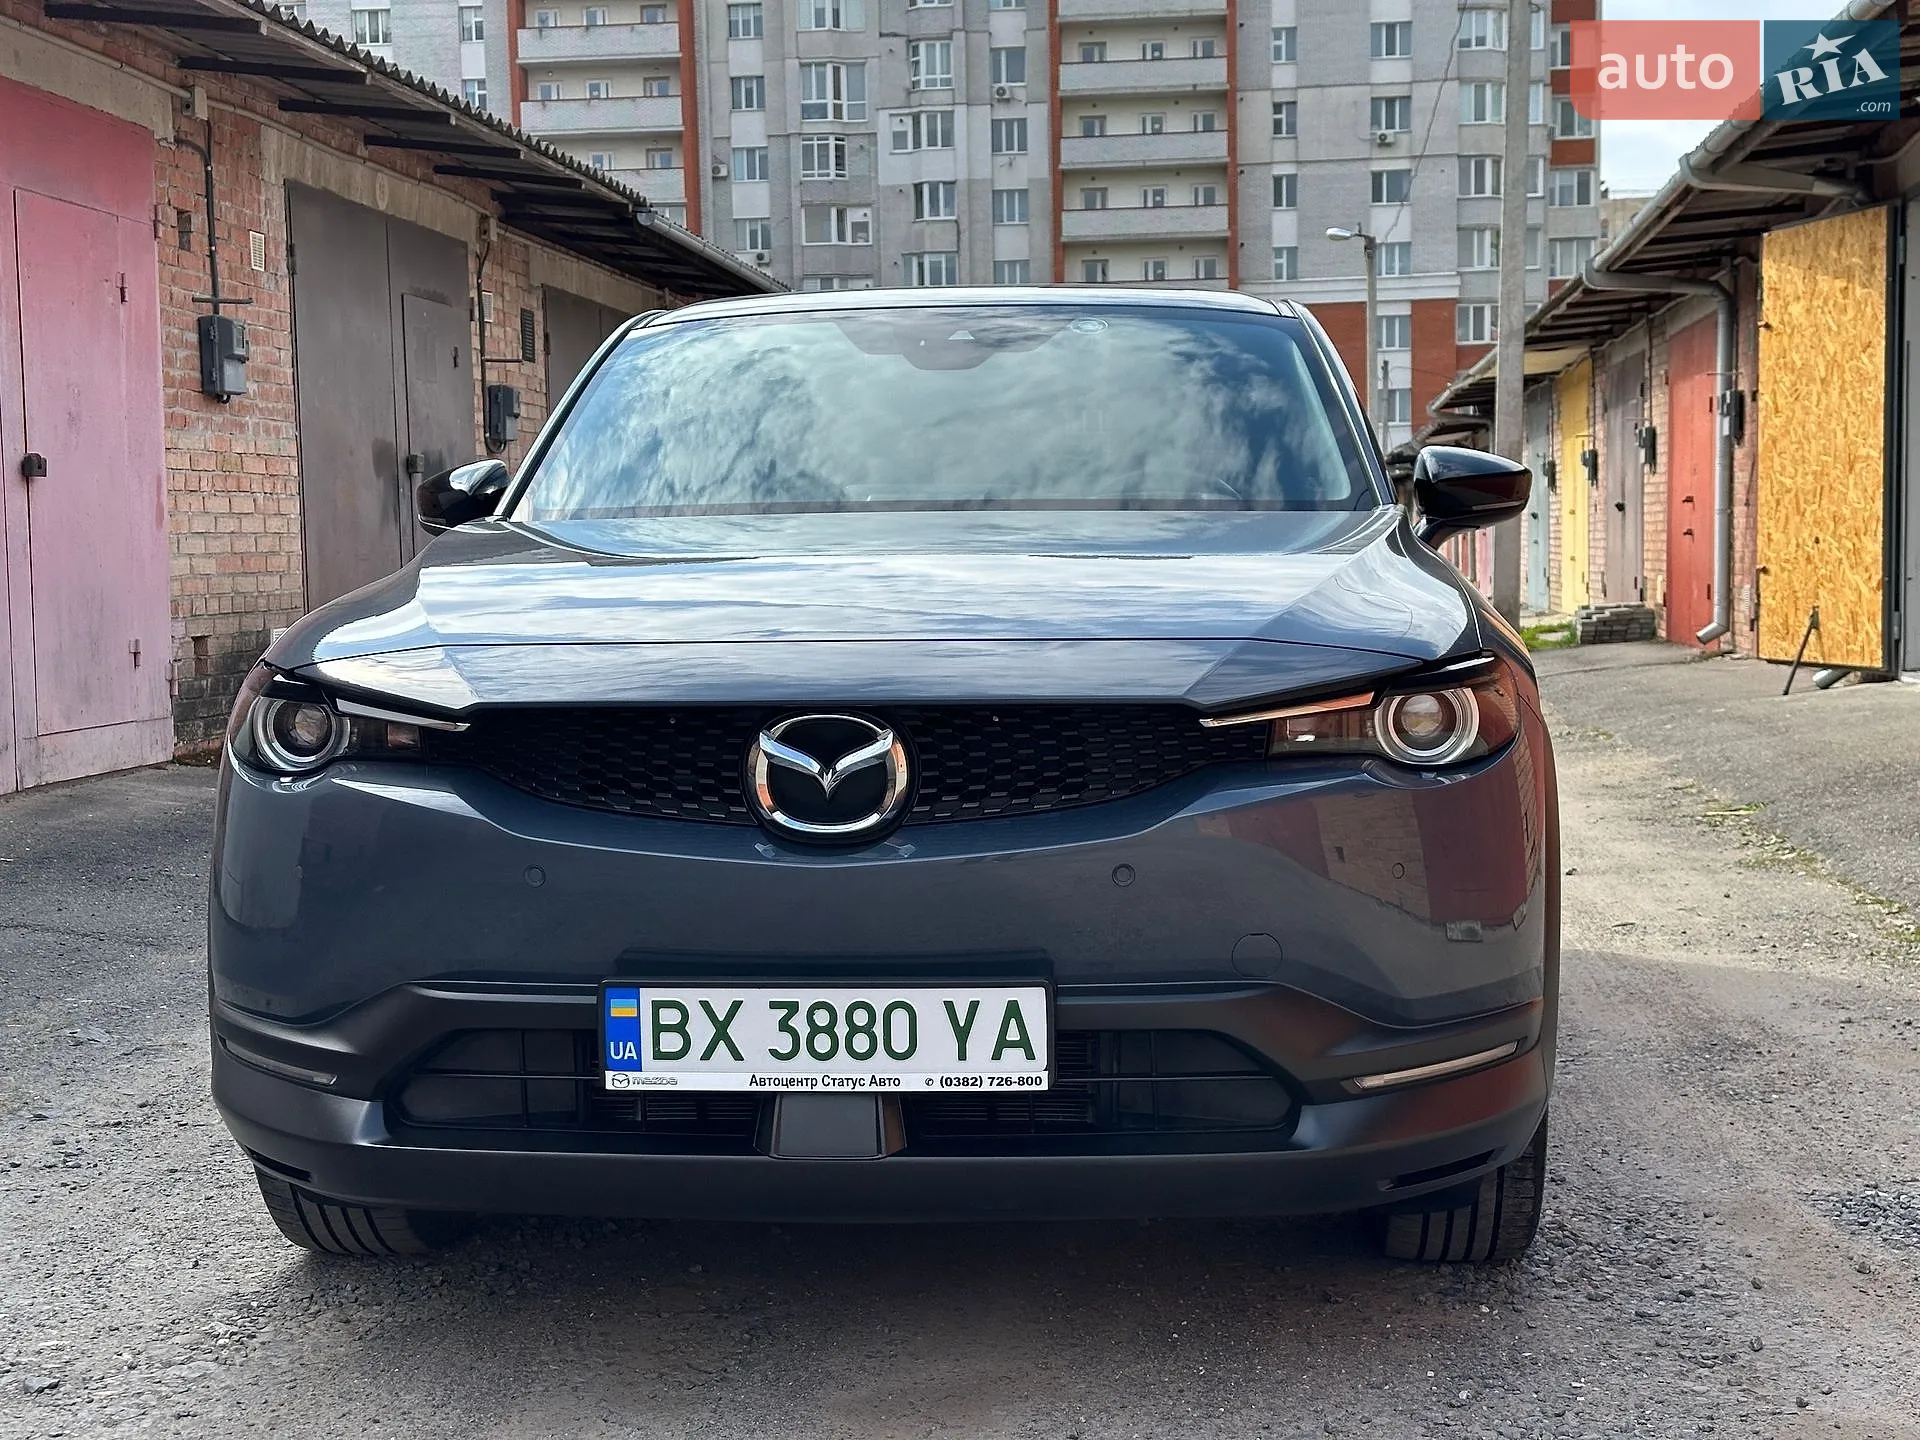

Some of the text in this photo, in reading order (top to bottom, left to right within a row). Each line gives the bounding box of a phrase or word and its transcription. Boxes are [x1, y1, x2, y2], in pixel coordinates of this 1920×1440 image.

[651, 1000, 1036, 1061] BX 3880 YA
[610, 1041, 638, 1060] UA
[749, 1074, 901, 1089] Автоцентр Статус Авто
[939, 1075, 1043, 1088] (0382) 726-800
